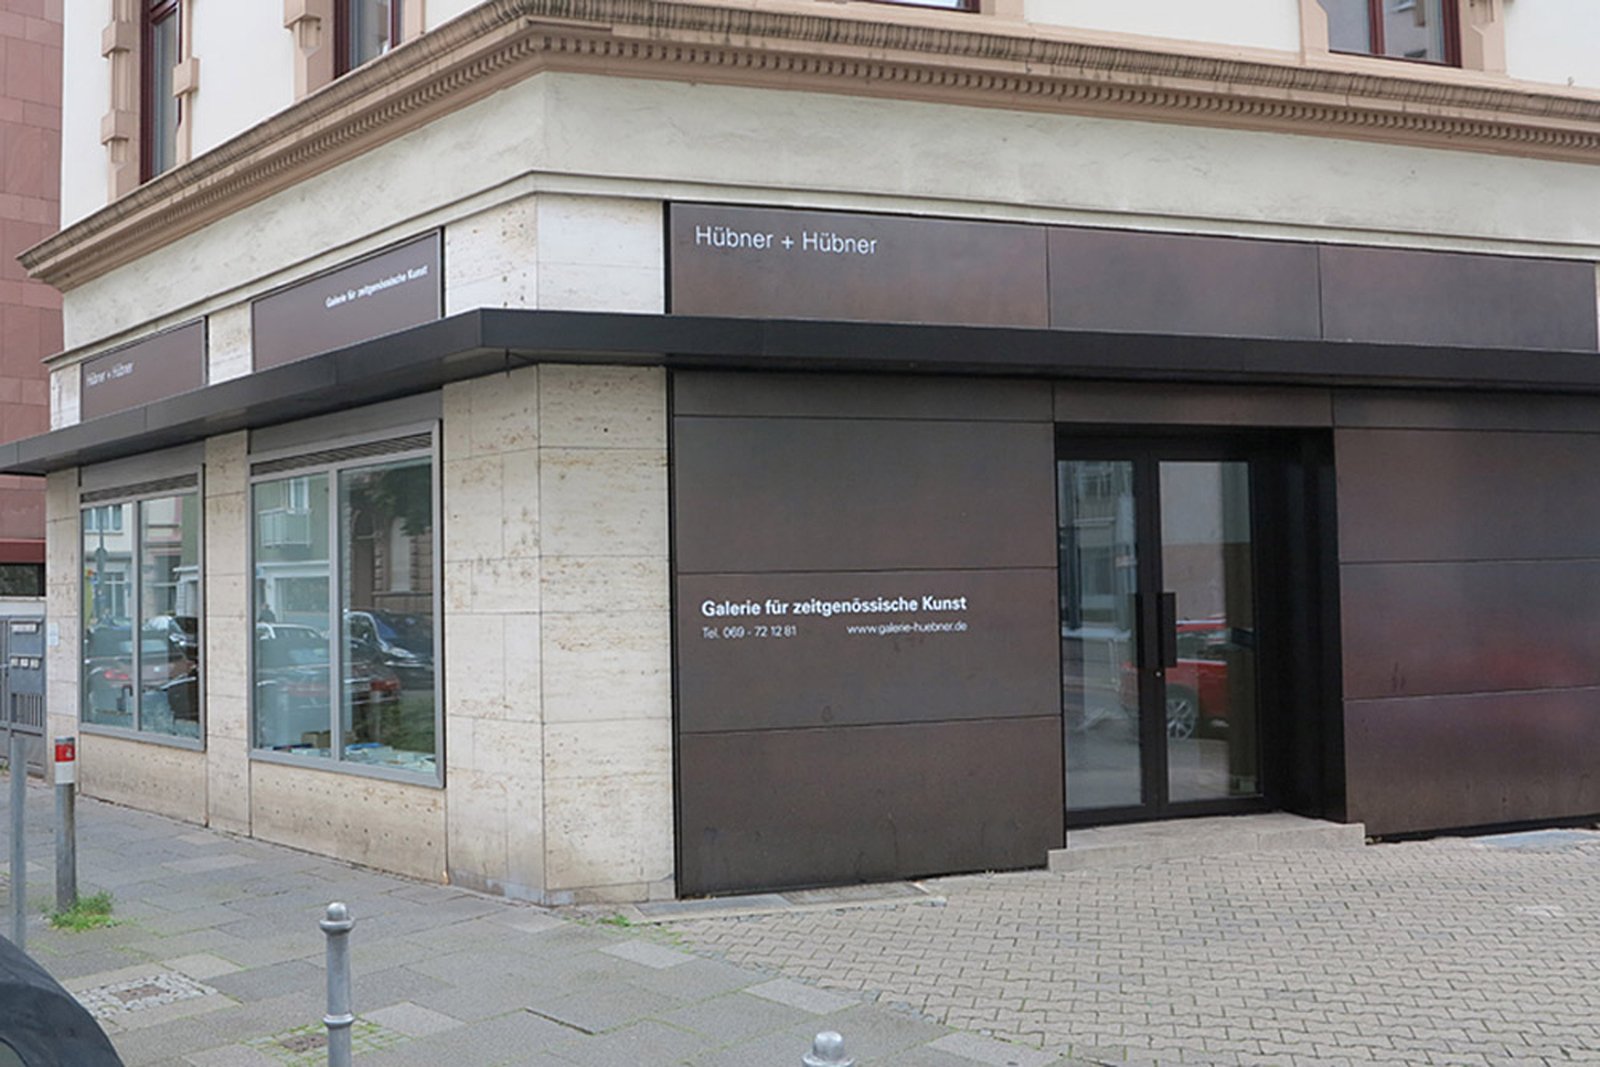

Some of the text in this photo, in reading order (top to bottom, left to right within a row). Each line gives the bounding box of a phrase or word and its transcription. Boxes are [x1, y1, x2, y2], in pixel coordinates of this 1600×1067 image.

[695, 225, 877, 254] Hübner + Hübner
[701, 595, 967, 618] Galerie für zeitgenössische Kunst
[722, 626, 746, 639] 069
[754, 625, 768, 638] 72
[770, 625, 782, 637] 12
[783, 625, 797, 637] 81
